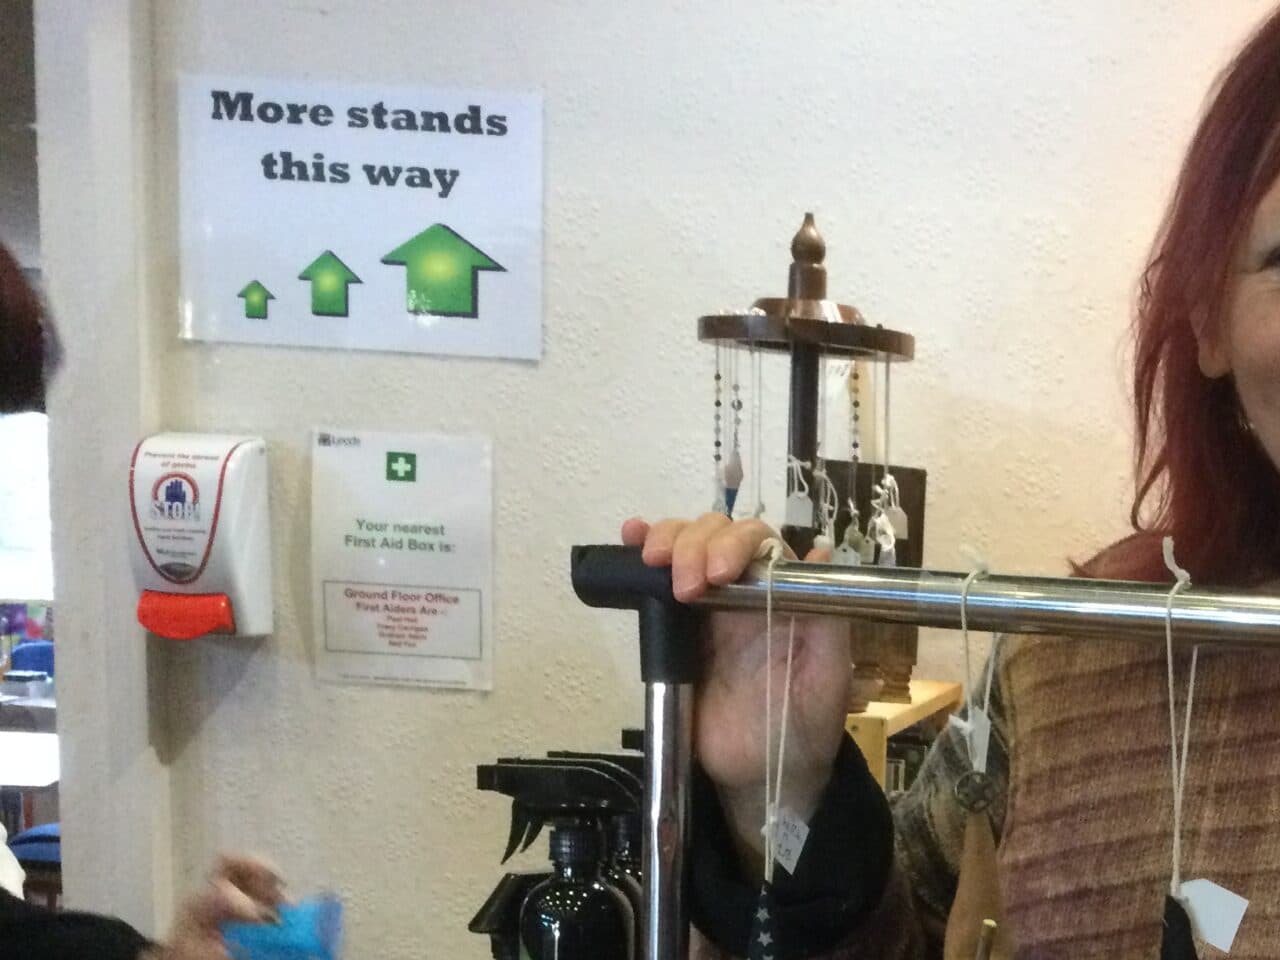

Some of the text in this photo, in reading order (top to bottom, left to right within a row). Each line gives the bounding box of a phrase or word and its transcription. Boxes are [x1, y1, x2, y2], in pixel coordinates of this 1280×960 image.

[211, 90, 508, 136] More stands
[260, 151, 460, 198] this way
[356, 518, 445, 536] Your nearest
[344, 535, 376, 548] First
[379, 537, 403, 549] Aid
[408, 538, 435, 552] Box
[344, 588, 460, 605] Ground Floor Office
[383, 603, 416, 615] Aiders
[419, 605, 438, 616] Are
